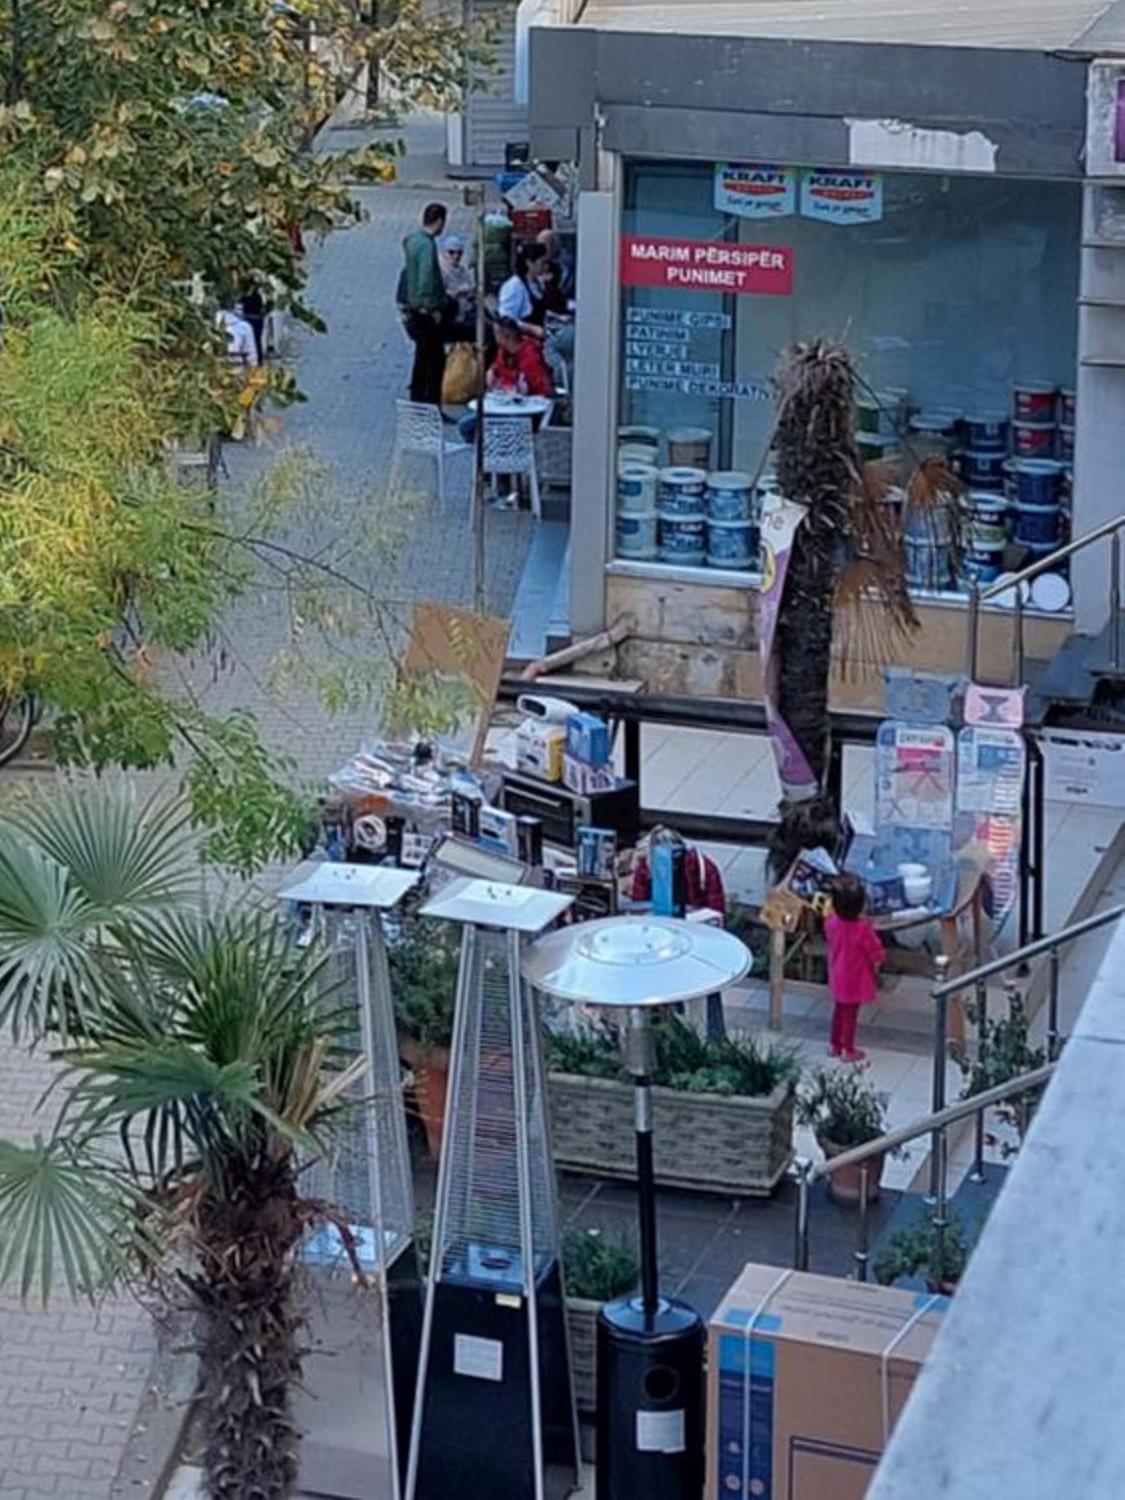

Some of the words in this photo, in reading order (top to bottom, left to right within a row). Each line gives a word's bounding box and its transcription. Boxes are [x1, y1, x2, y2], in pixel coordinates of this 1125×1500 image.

[723, 170, 786, 185] KRAFT
[810, 174, 874, 189] KRAFT
[631, 243, 690, 262] MARIM
[695, 246, 785, 270] PËRSIPËR
[666, 266, 747, 286] PUNIMET
